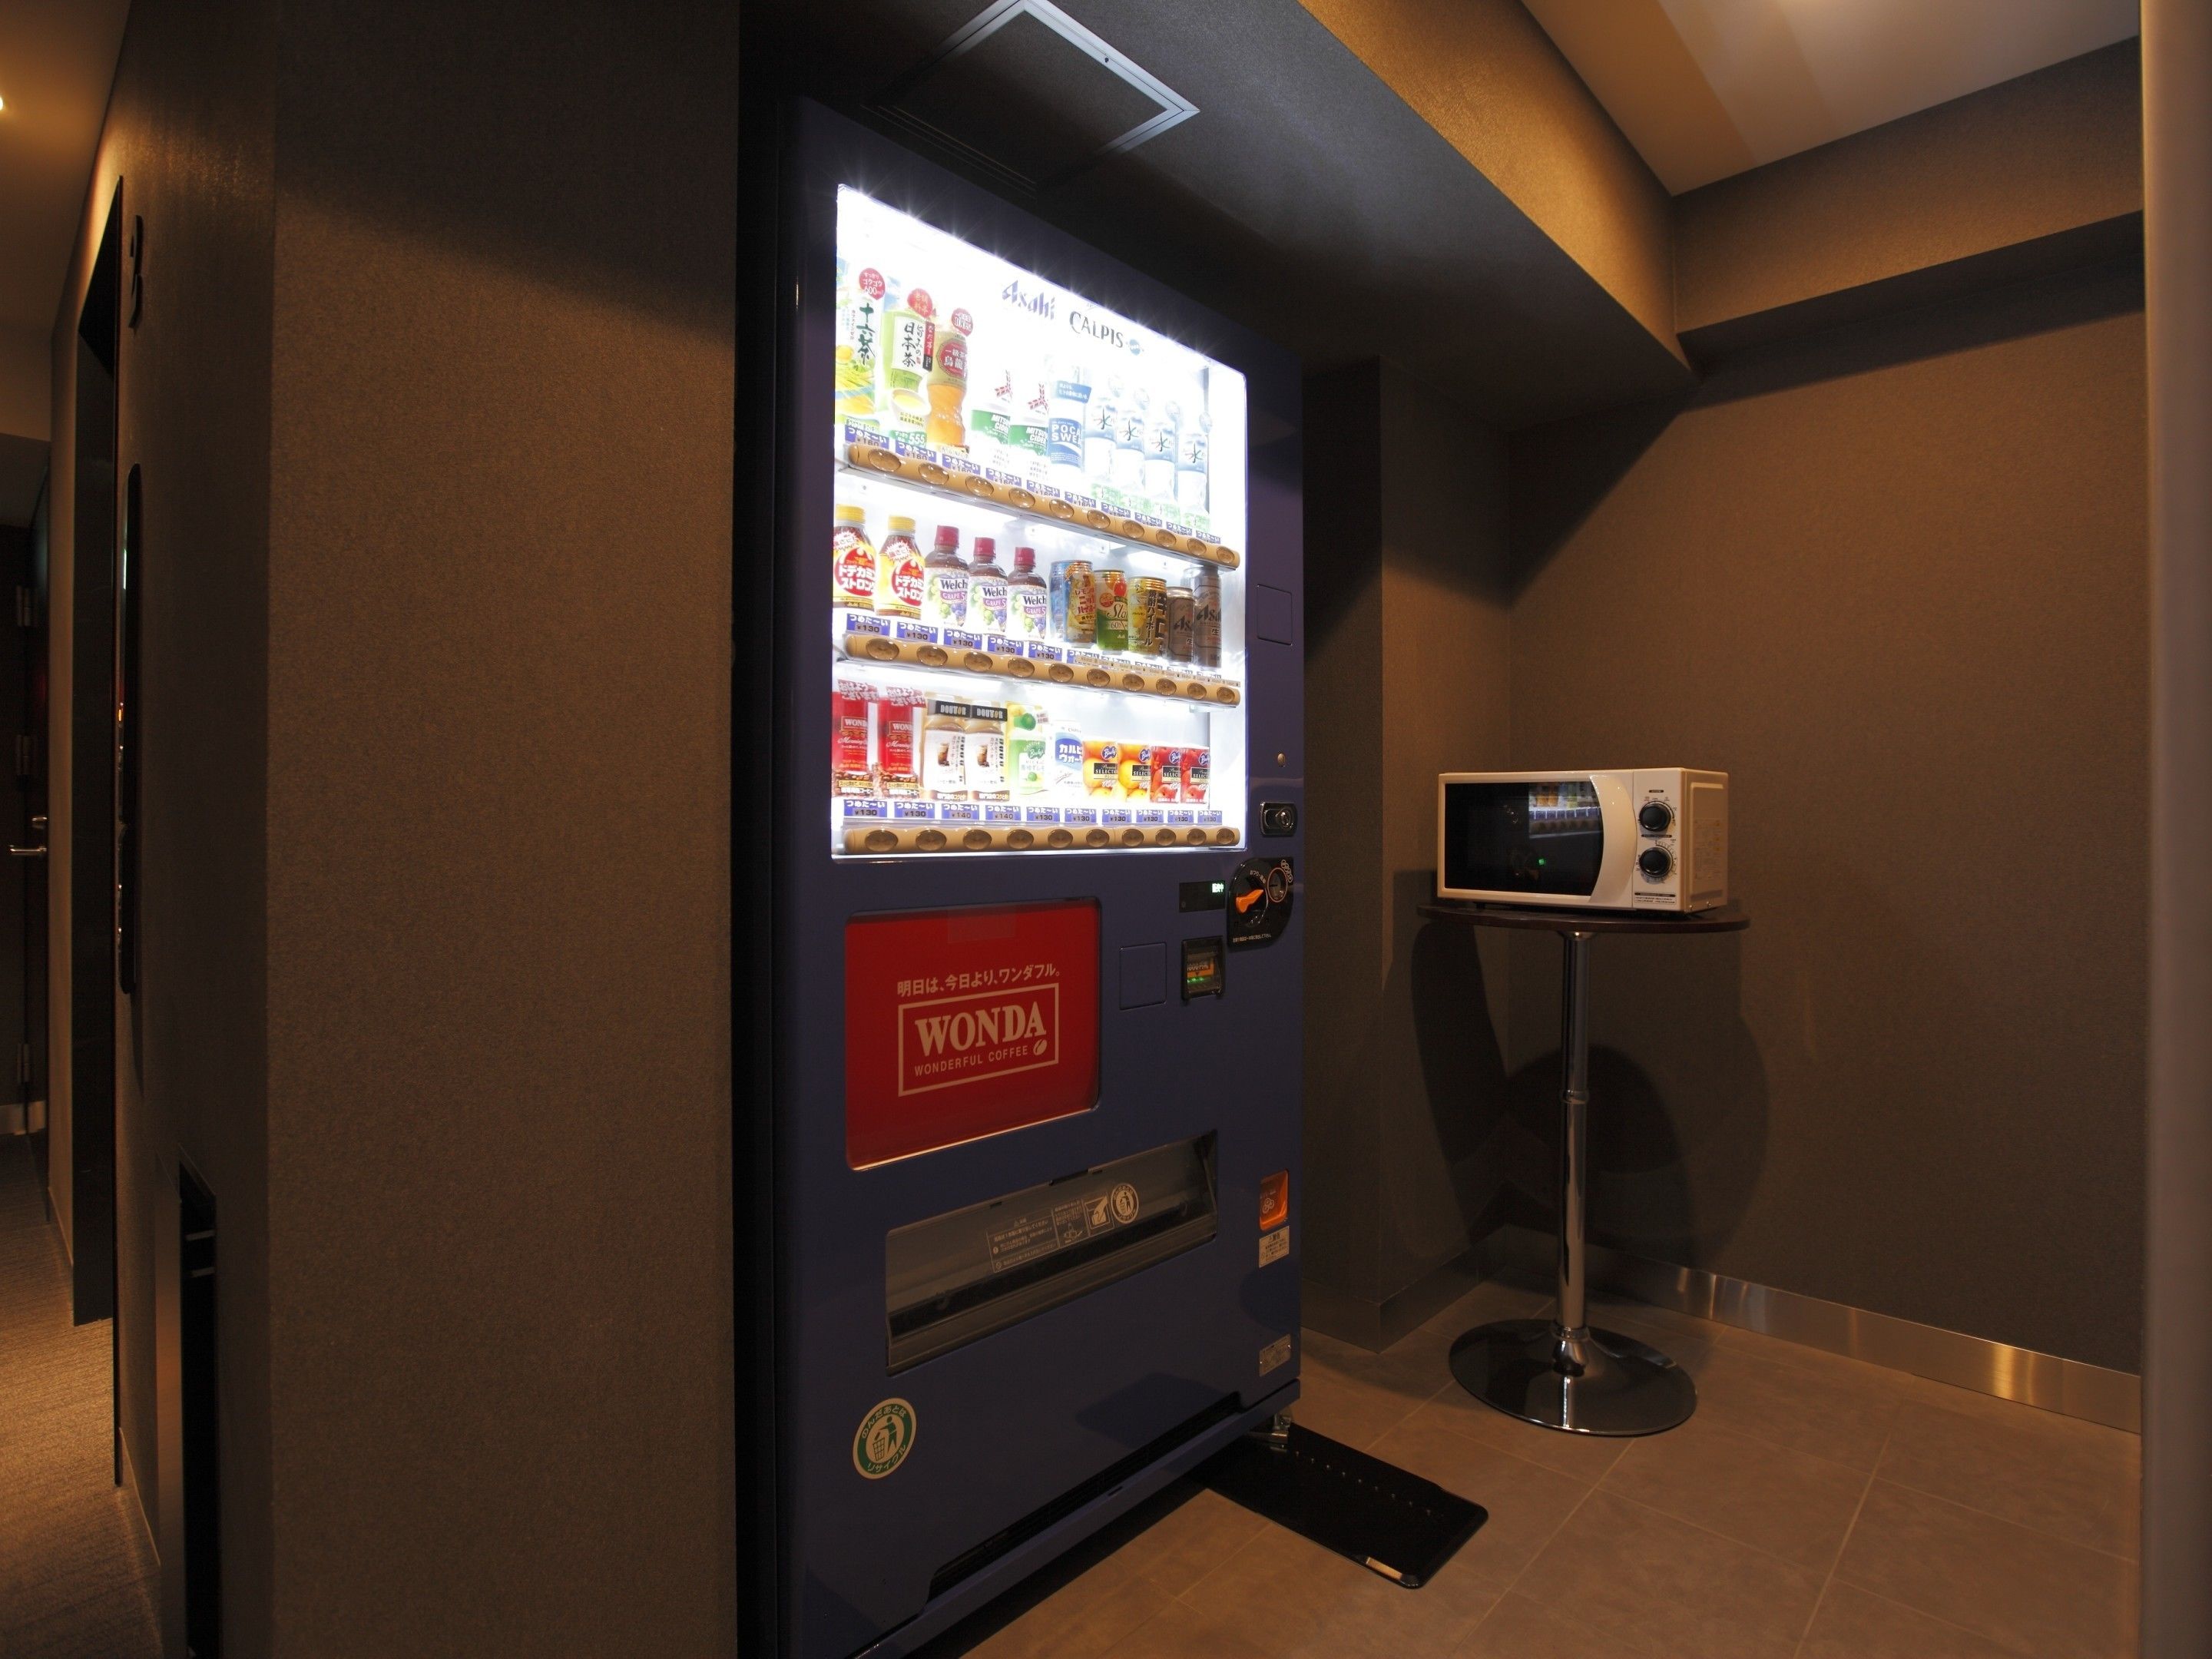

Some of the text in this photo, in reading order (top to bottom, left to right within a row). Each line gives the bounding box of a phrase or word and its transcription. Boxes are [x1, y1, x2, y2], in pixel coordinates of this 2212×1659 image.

[1002, 280, 1055, 320] Asahi
[856, 302, 876, 366] 十六茶
[902, 322, 916, 368] 日本茶
[1069, 310, 1124, 349] CALPIS
[1023, 595, 1047, 605] Welch
[906, 632, 928, 641] ¥130
[940, 704, 966, 716] DOUTOR
[897, 963, 1061, 997] 明日は、今日より、ワンダフル。
[915, 1002, 1047, 1058] WONDA
[914, 1045, 1028, 1077] WONDERFUL COFFEE
[862, 1406, 907, 1439] のんだあとは
[867, 1445, 906, 1473] リサイクル
